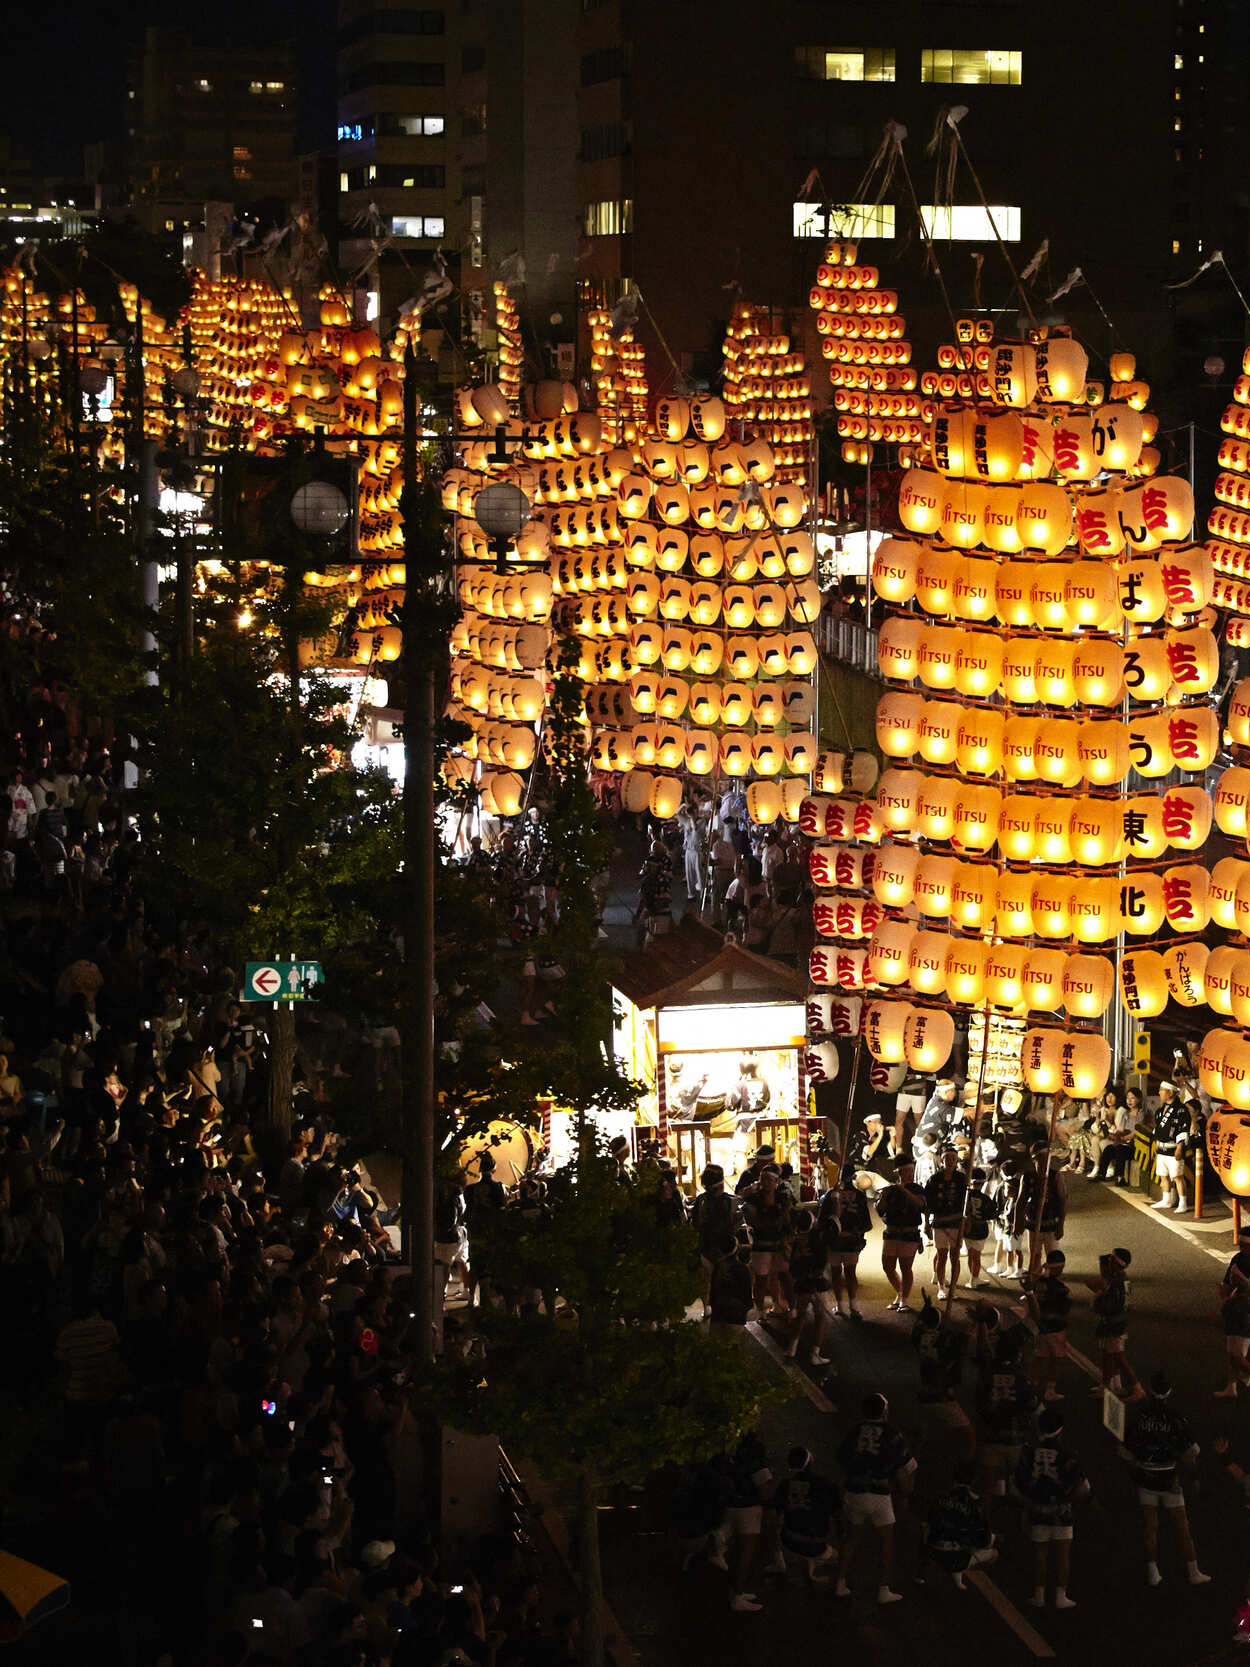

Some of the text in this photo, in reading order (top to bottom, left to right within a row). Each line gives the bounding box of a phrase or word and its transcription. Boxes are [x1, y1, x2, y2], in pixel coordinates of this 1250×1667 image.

[869, 1011, 882, 1055] 富士通
[912, 1016, 927, 1049] 富士通
[1030, 1036, 1044, 1070] 富士通
[1062, 1043, 1074, 1088] 富士通
